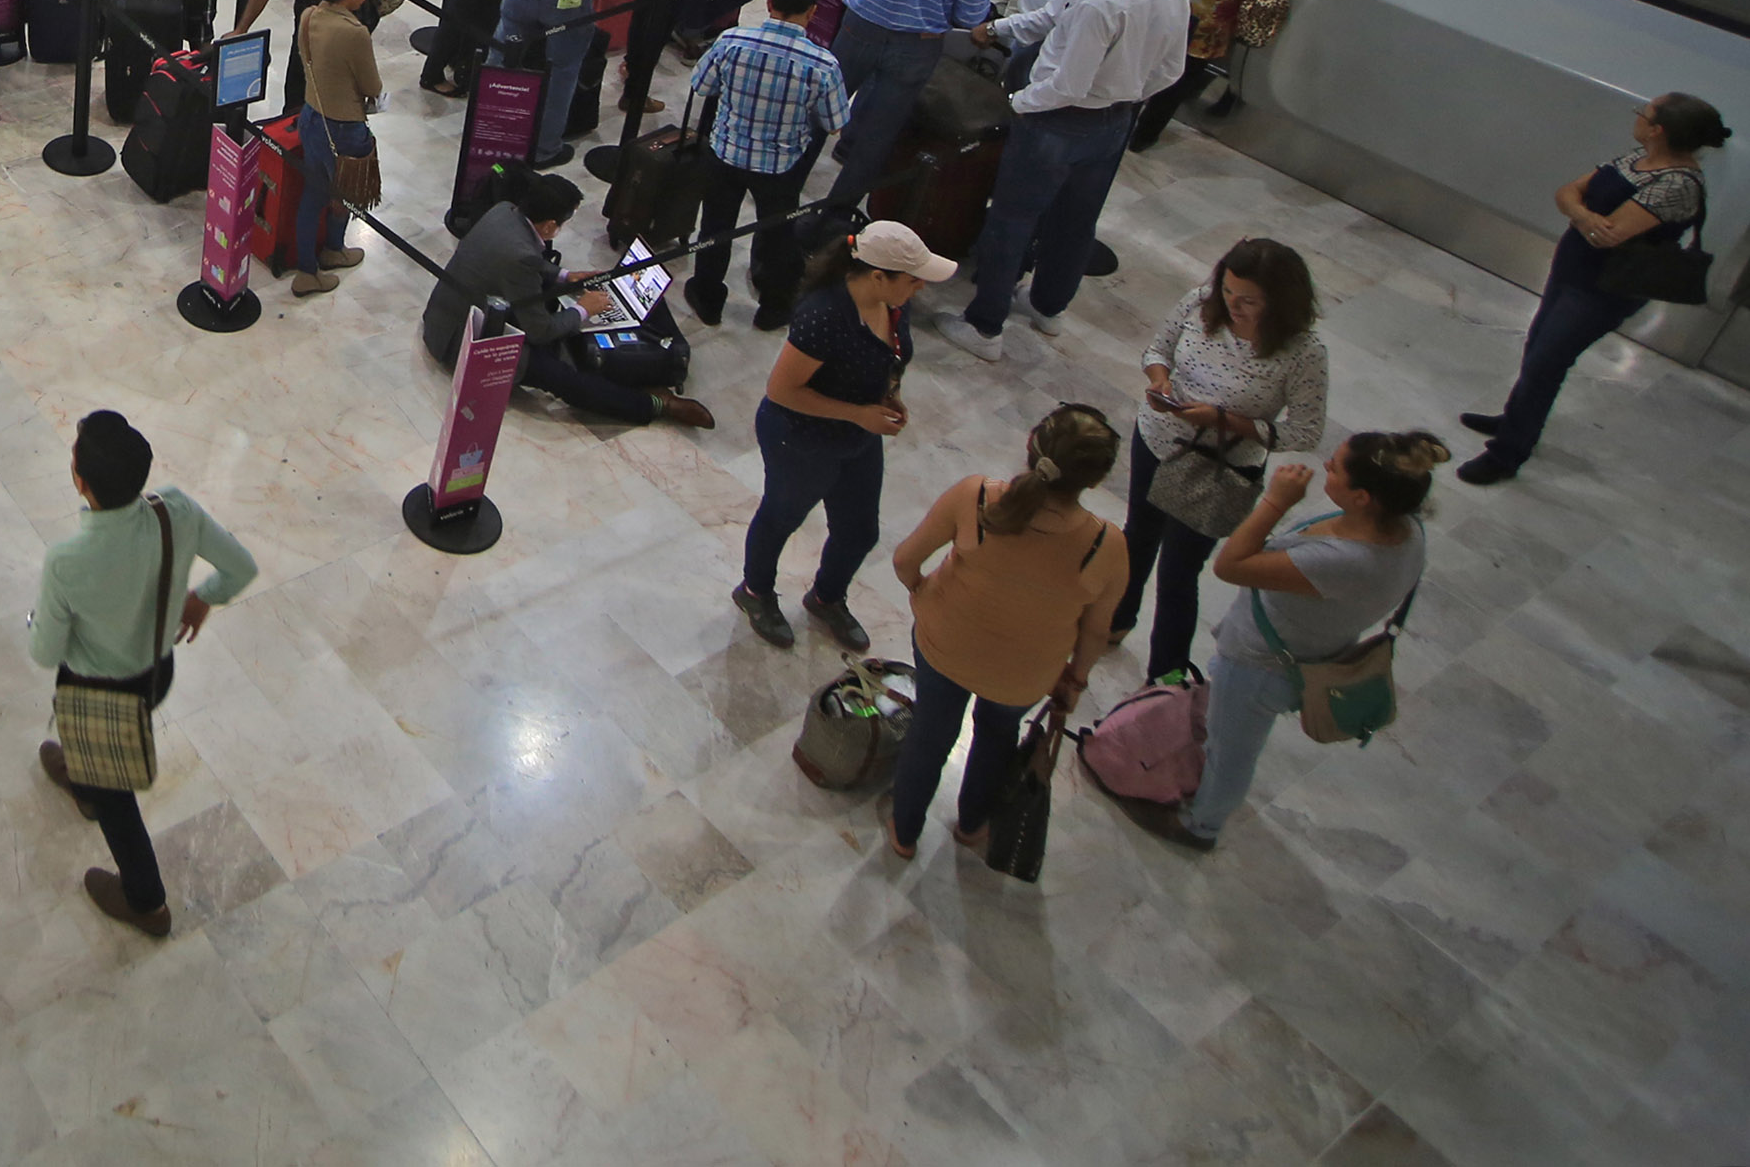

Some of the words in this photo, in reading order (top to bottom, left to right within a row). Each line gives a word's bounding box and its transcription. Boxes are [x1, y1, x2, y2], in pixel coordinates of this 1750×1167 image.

[261, 135, 283, 156] volaris
[342, 199, 367, 221] volaris
[786, 206, 812, 220] volaris
[688, 238, 715, 253] volaris
[582, 272, 612, 287] volaris
